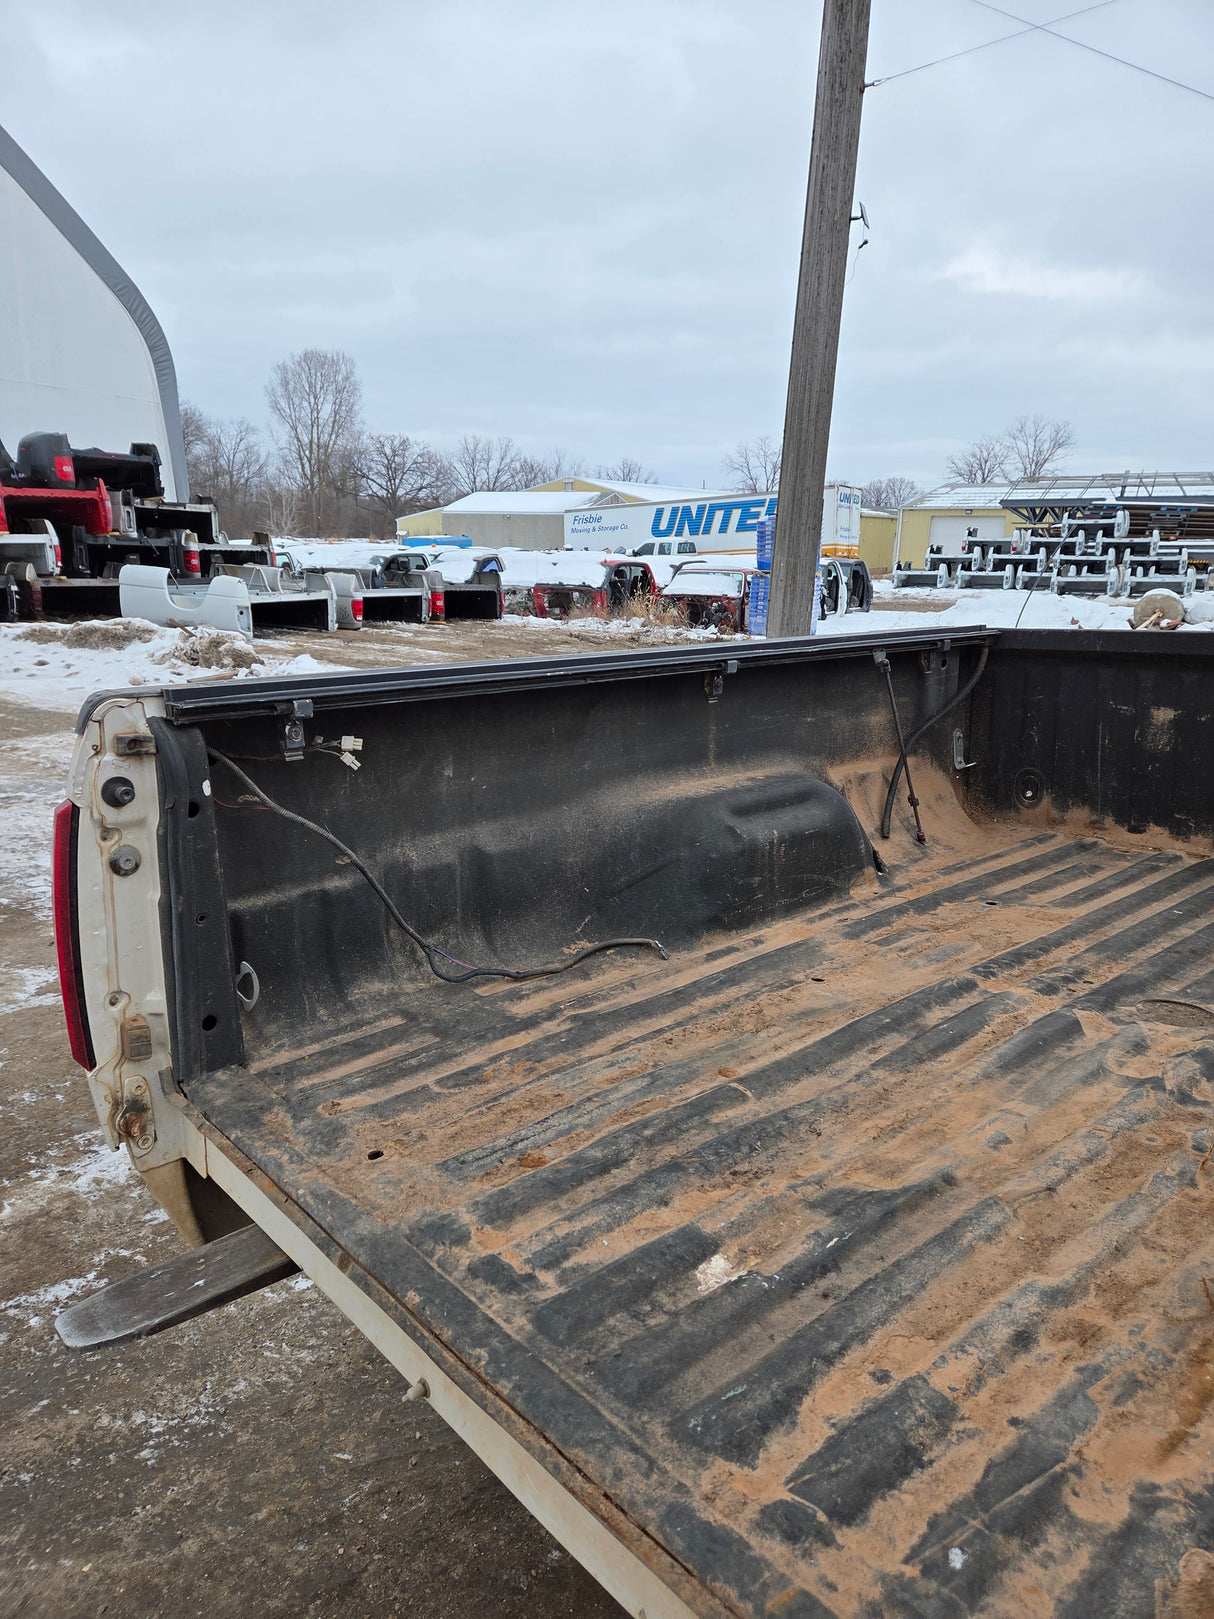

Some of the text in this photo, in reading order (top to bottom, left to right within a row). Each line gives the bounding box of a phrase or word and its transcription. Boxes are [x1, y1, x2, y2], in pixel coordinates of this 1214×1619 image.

[572, 513, 603, 525] Frisbie
[570, 526, 591, 534] Moving
[597, 524, 619, 533] Storage
[619, 523, 630, 531] Co.
